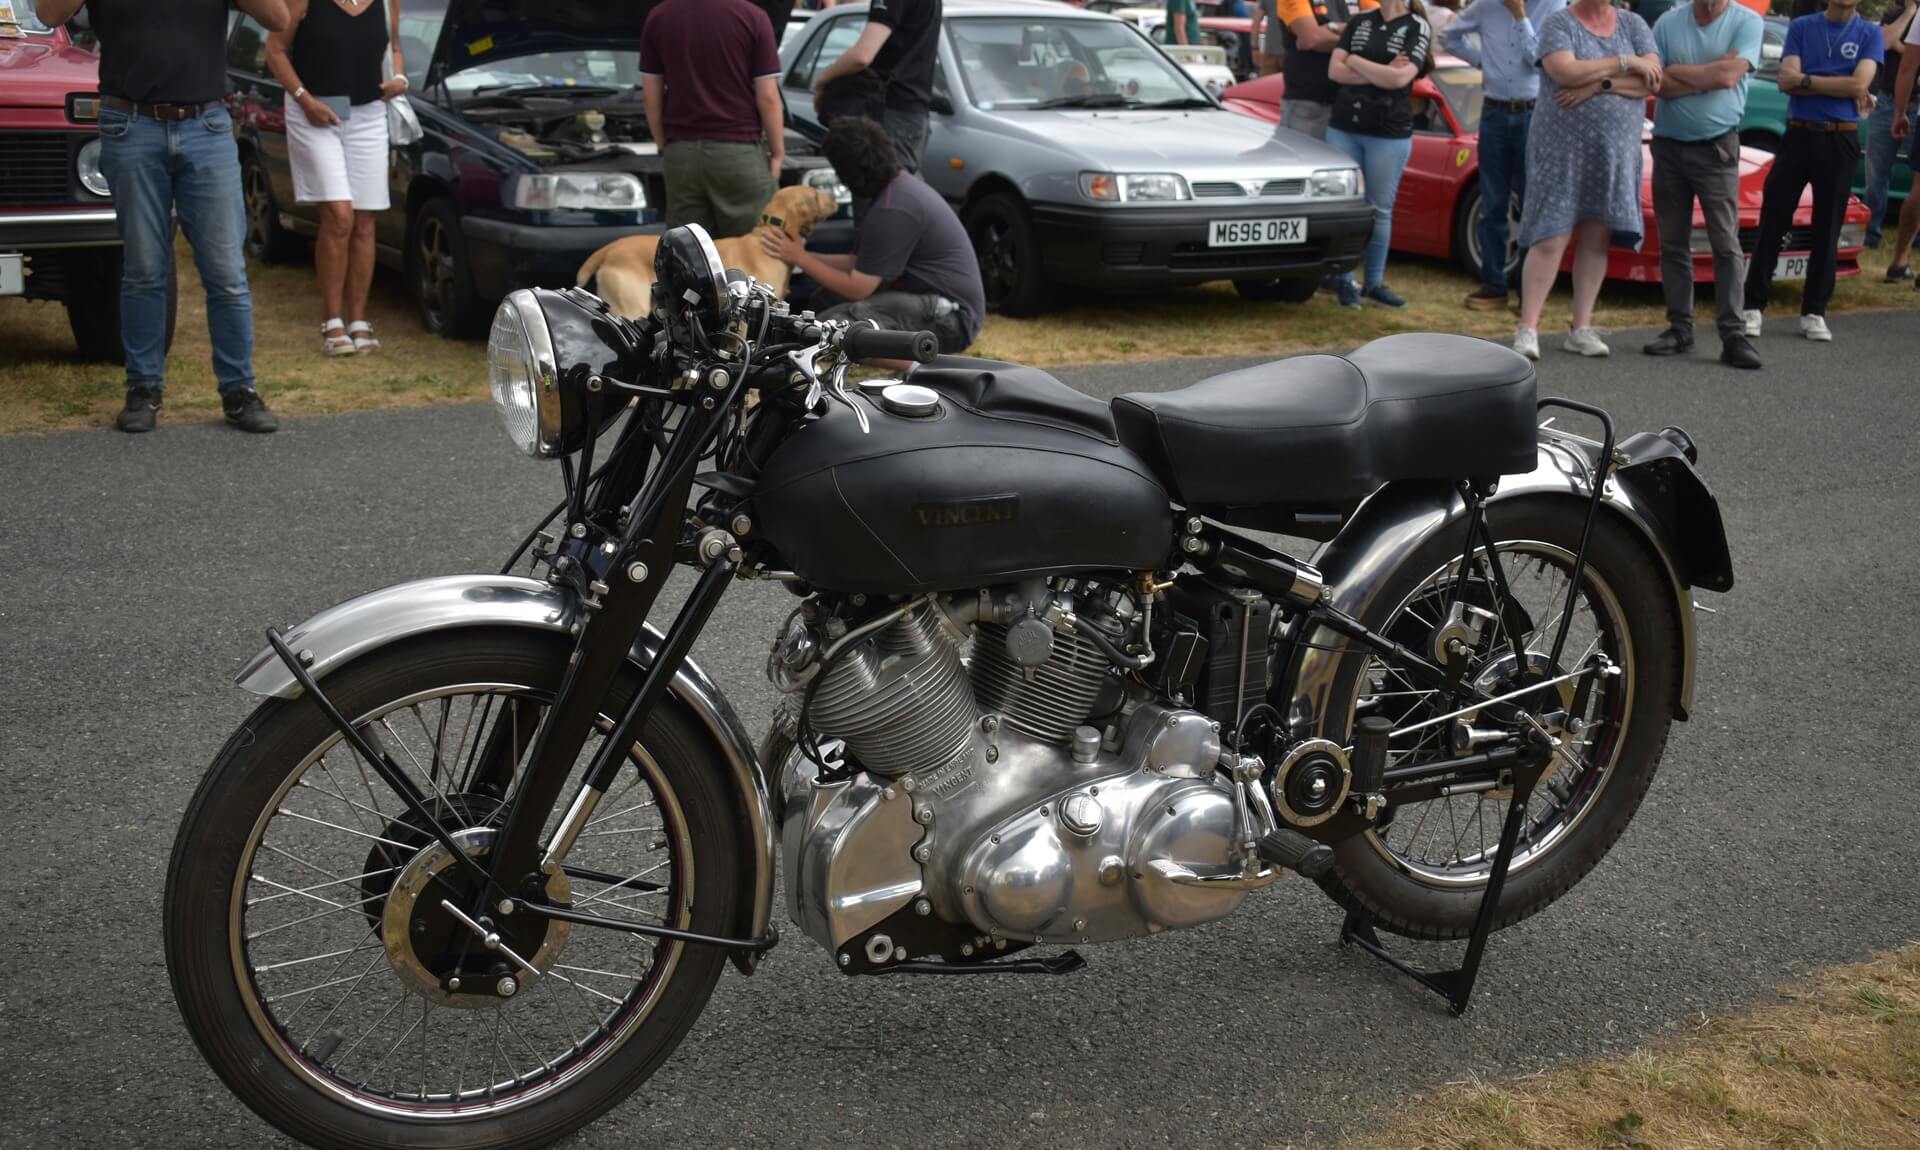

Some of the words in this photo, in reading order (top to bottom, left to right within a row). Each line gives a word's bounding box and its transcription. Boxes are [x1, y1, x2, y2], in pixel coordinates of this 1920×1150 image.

[1216, 223, 1262, 243] M696
[1267, 221, 1300, 241] ORX
[1785, 258, 1808, 276] PO
[918, 504, 1014, 526] VINCENT
[932, 765, 973, 795] VINCENT
